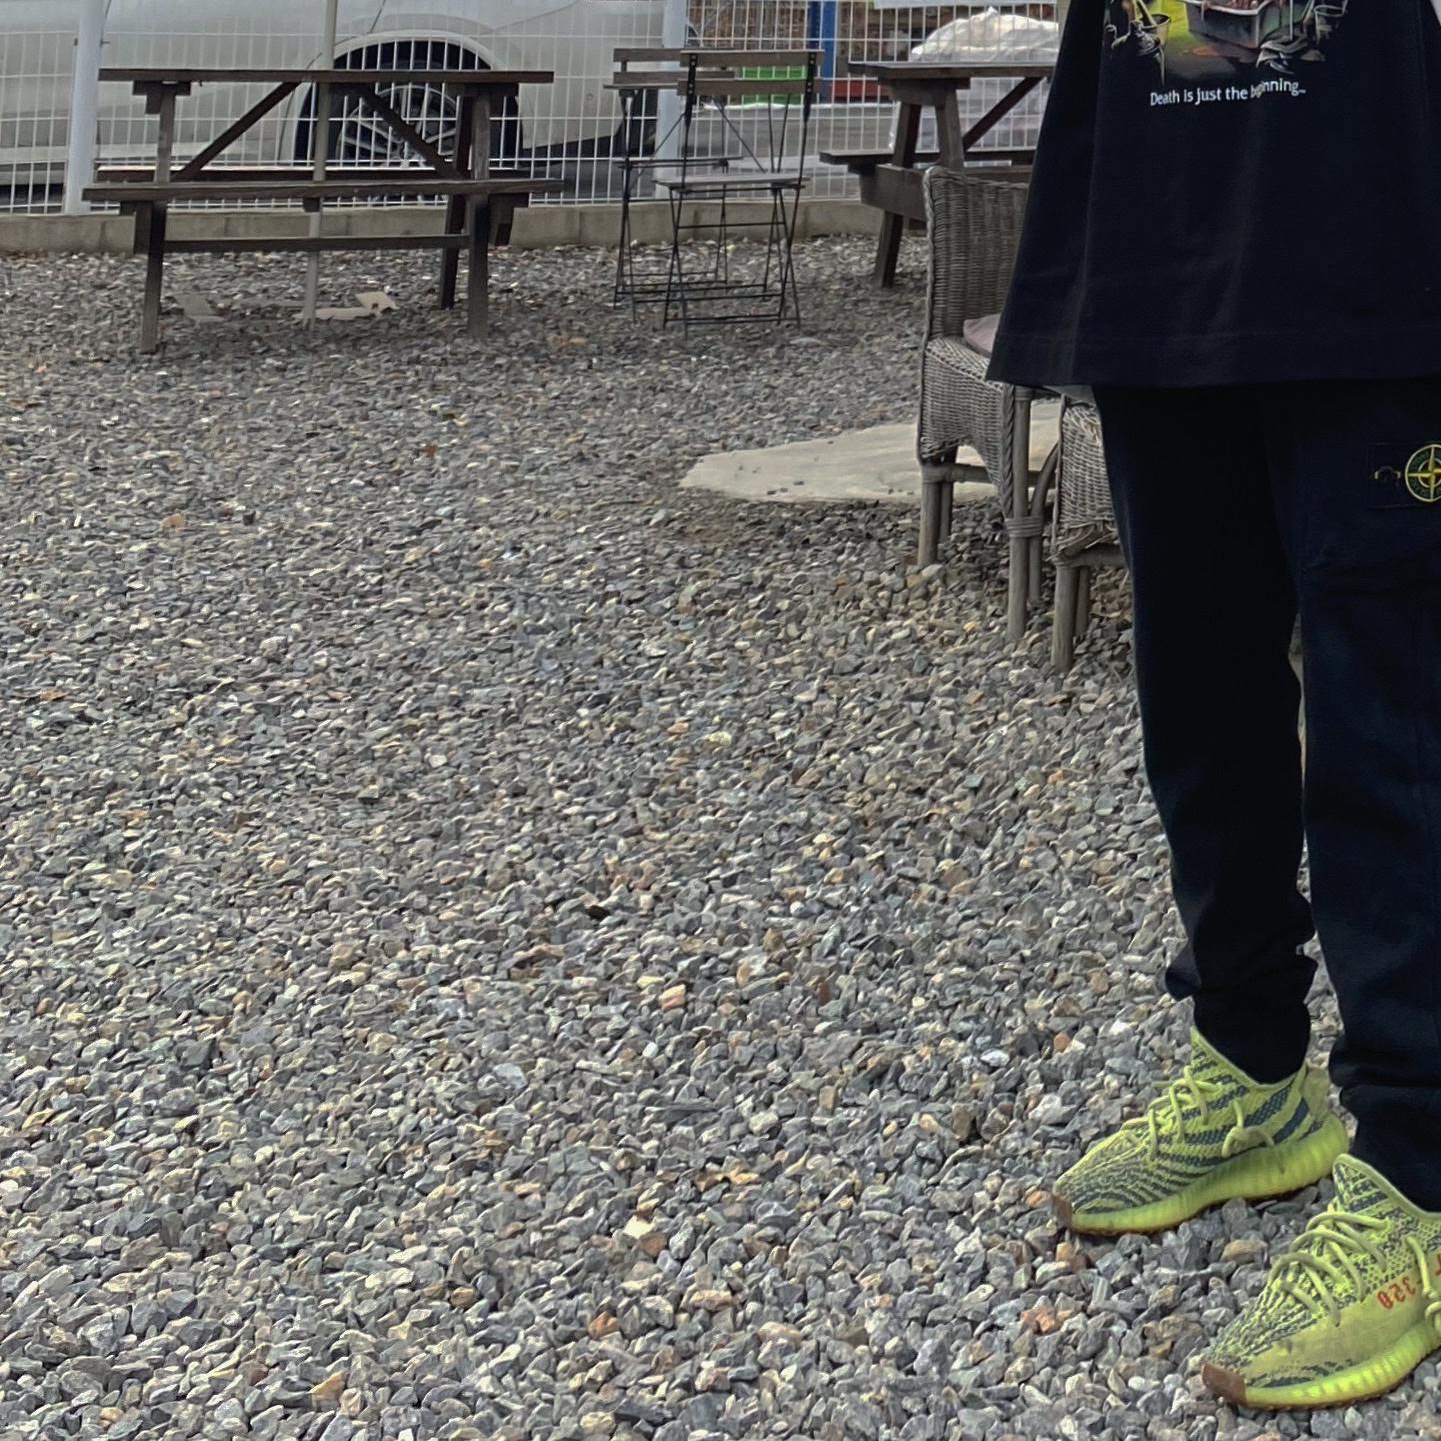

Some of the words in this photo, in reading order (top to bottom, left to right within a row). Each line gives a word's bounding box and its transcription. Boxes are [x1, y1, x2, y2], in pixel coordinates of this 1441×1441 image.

[1150, 89, 1180, 106] Death
[1183, 88, 1194, 103] is
[1194, 87, 1222, 105] just
[1225, 86, 1248, 101] the
